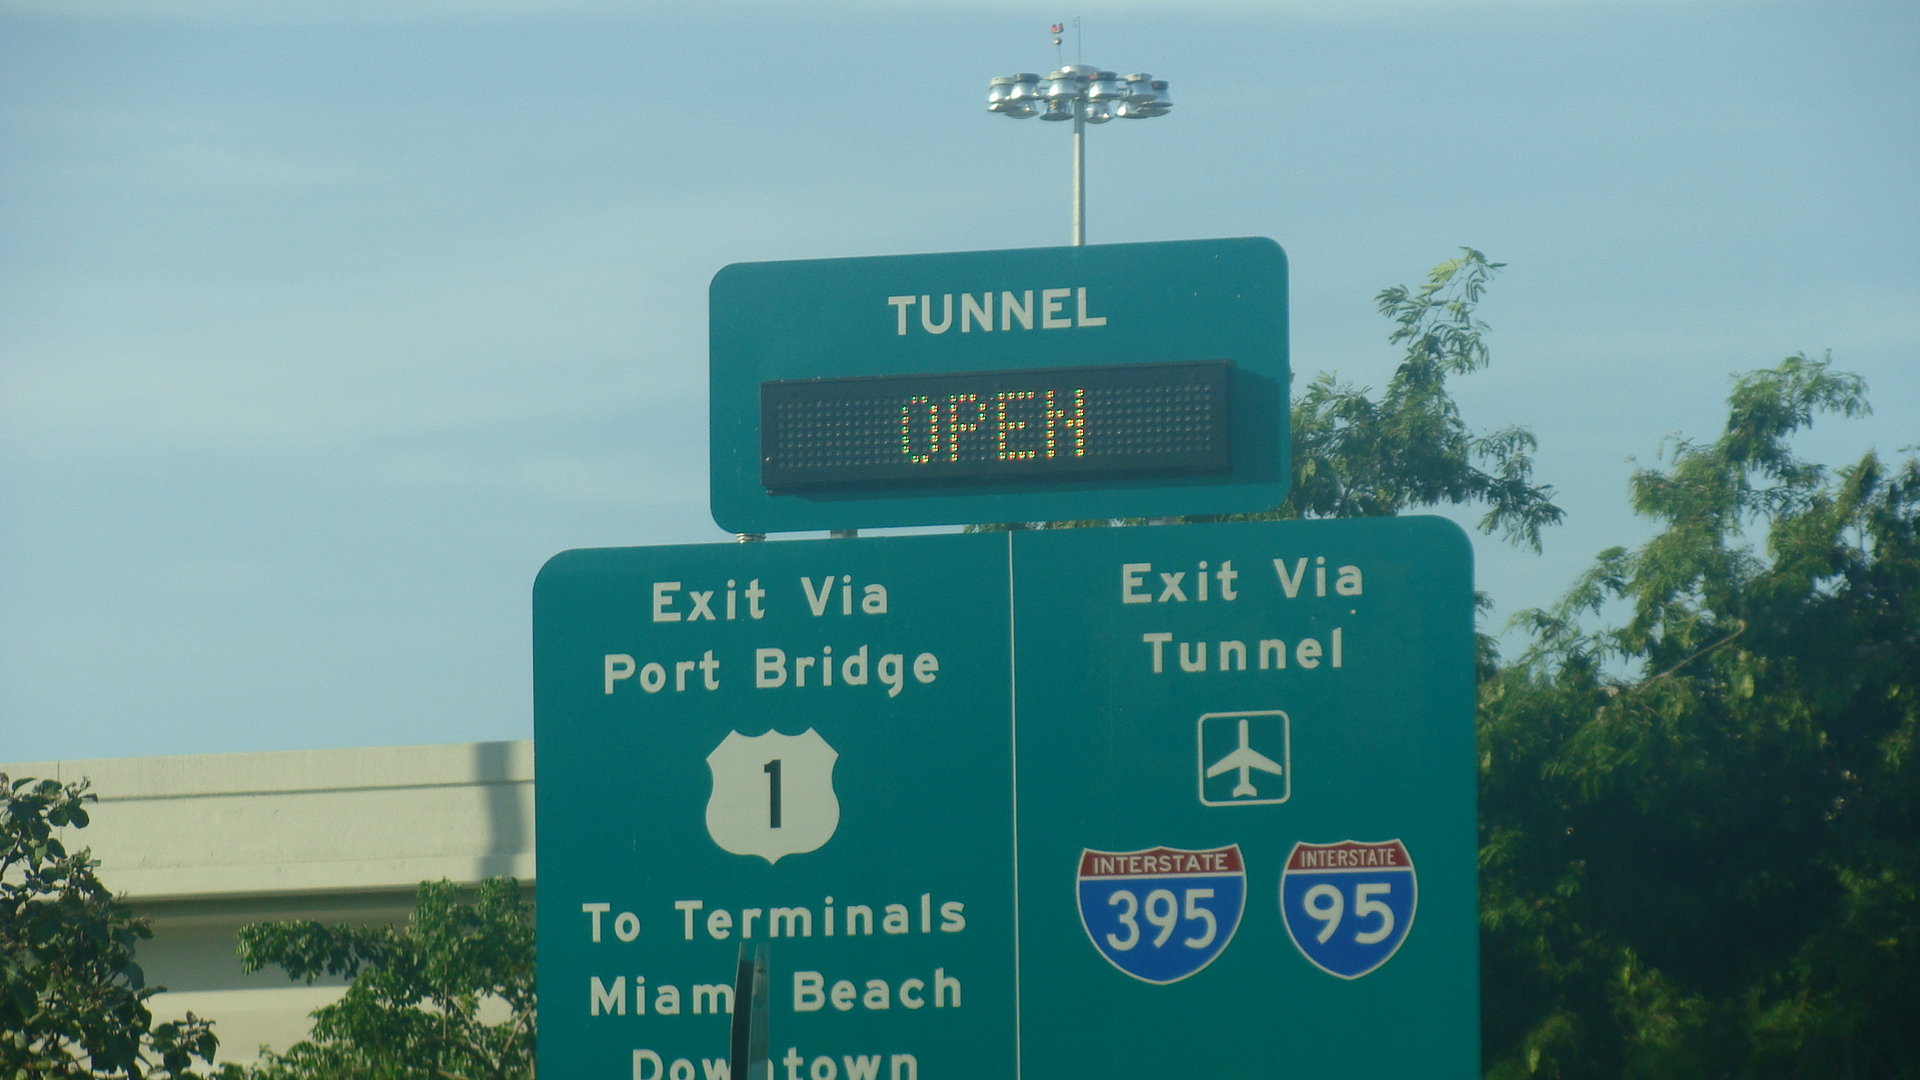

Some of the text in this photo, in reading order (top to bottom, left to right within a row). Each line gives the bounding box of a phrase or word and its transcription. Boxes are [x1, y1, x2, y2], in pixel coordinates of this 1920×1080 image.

[888, 287, 1107, 335] TUNNEL
[900, 388, 1086, 464] OPEN
[652, 574, 888, 624] Exit Via
[1121, 556, 1364, 604] Exit Via
[603, 644, 940, 699] Port Bridge
[1143, 627, 1343, 674] Tunnel
[763, 758, 782, 829] 1
[1093, 852, 1229, 875] INTERSTATE
[1300, 847, 1397, 868] INTERSTATE
[582, 892, 966, 943] To Terminals
[1105, 888, 1218, 951] 395
[1303, 882, 1396, 945] 95
[590, 967, 962, 1017] Miam Beach
[632, 1047, 918, 1080] Dowtown
